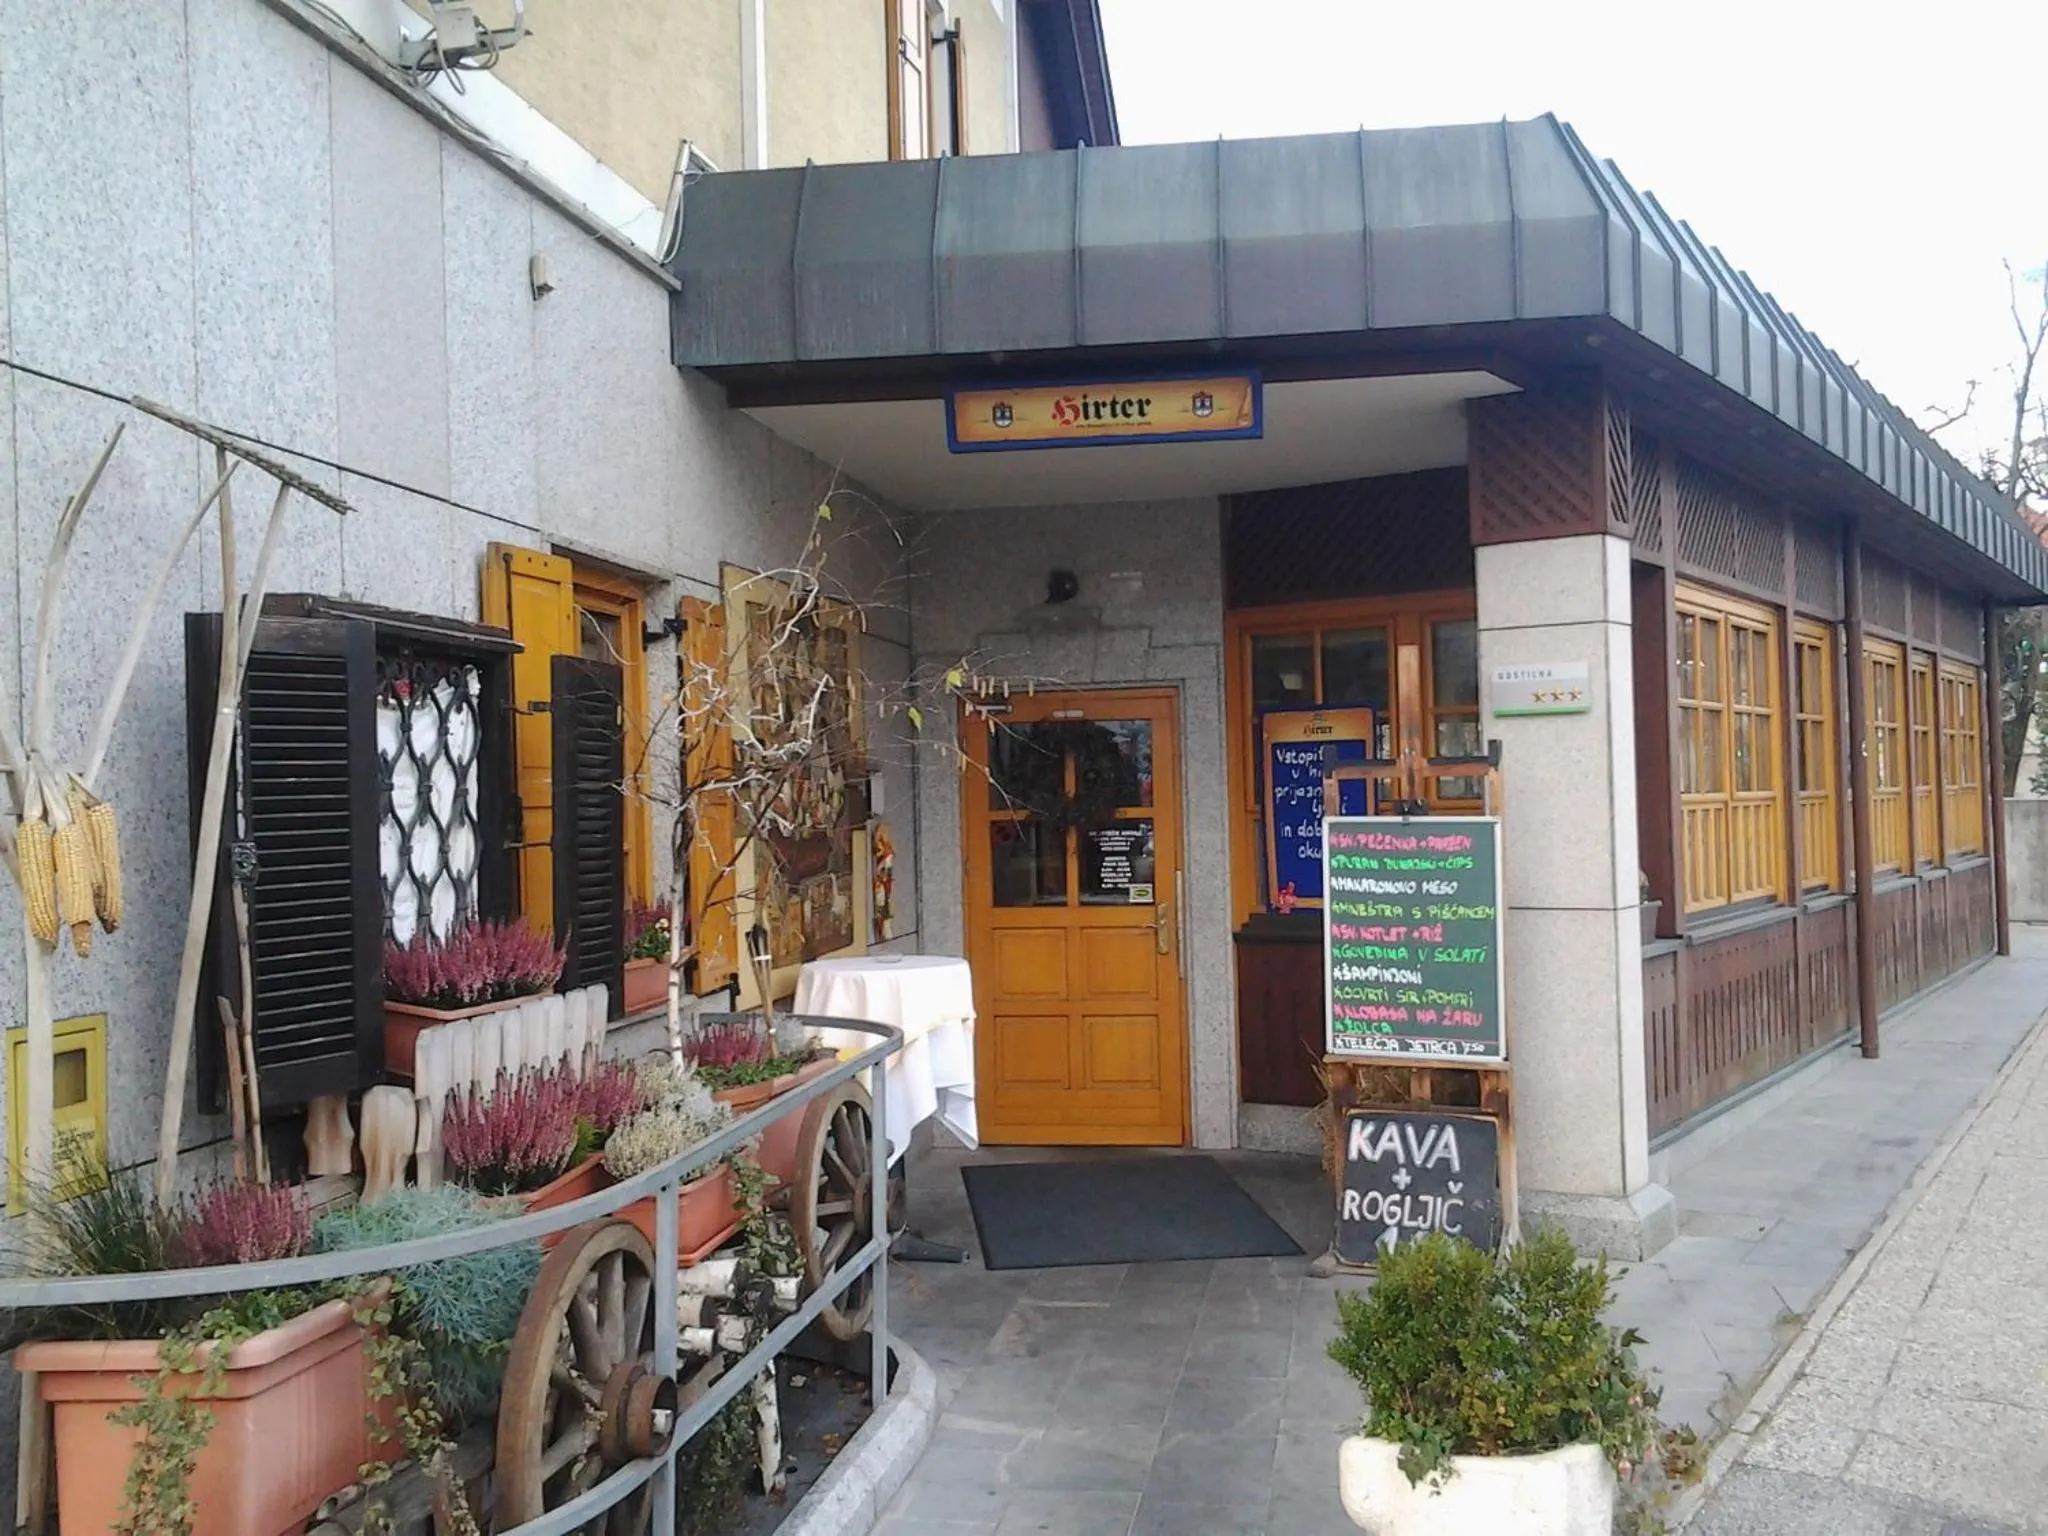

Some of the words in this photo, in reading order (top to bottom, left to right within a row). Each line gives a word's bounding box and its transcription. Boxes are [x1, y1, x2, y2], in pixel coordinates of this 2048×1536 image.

[1051, 394, 1152, 425] Hirter
[1418, 947, 1428, 962] V
[1348, 1118, 1461, 1173] KAVA
[1342, 1180, 1465, 1234] ROGLJIČ
